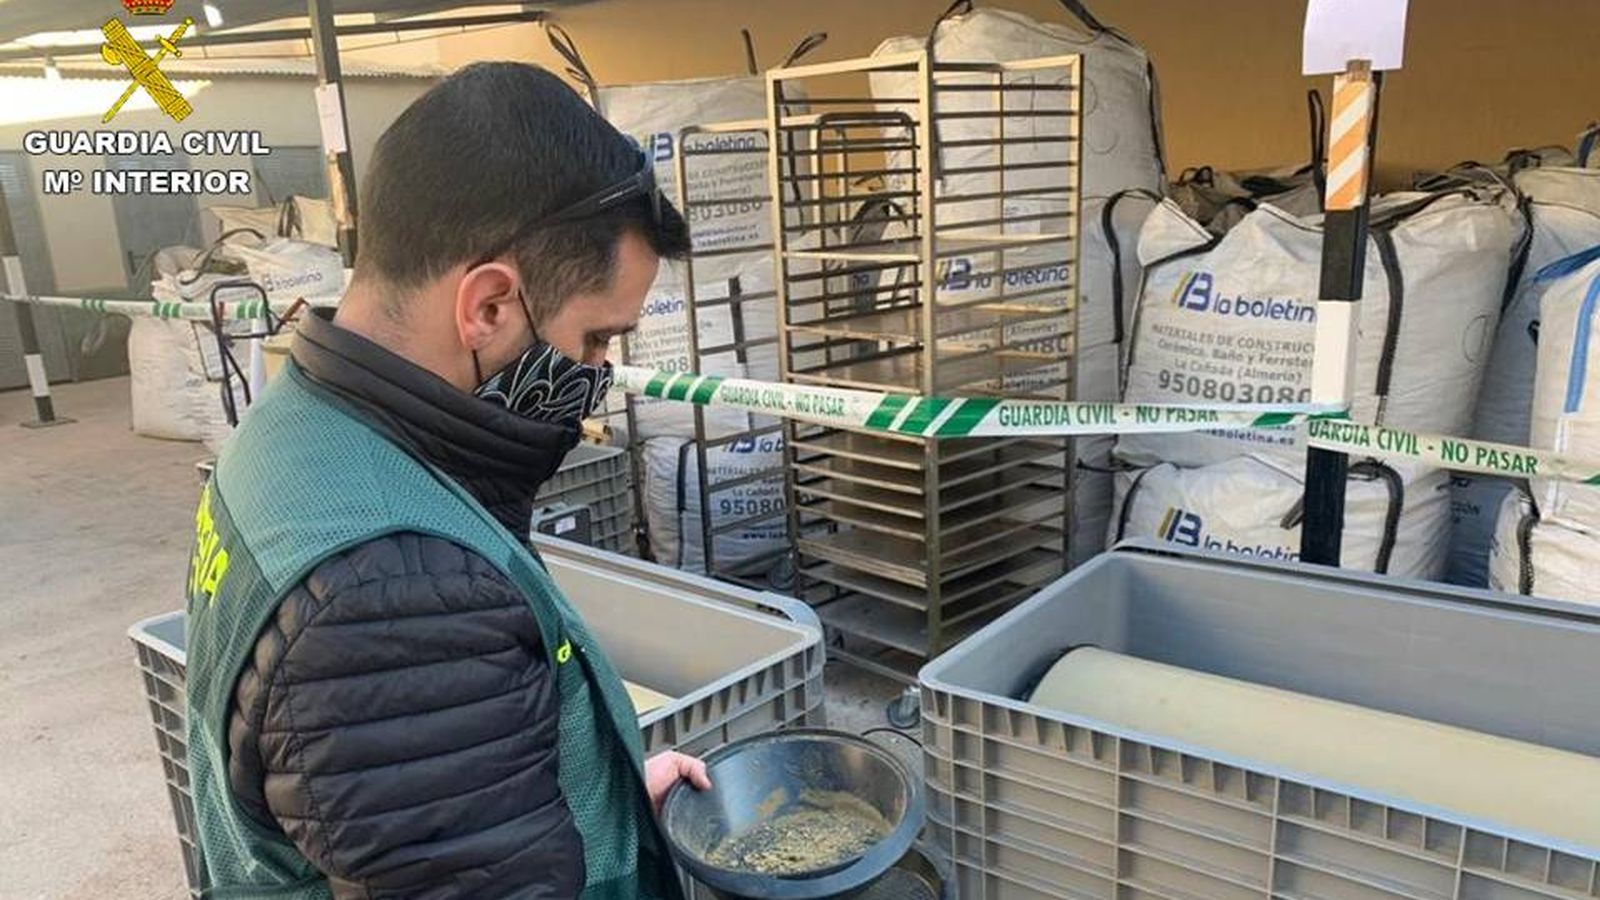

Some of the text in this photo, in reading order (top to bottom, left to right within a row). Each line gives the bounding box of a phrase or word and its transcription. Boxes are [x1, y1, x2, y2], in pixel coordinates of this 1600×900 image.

[1213, 293, 1231, 315] la
[1216, 334, 1233, 347] DE
[1158, 369, 1312, 404] 950803080
[1000, 405, 1070, 426] GUARDIA
[1076, 404, 1117, 425] CIVIL
[1136, 406, 1160, 424] NO
[1166, 407, 1219, 423] PASAR
[1376, 427, 1420, 456] CIVIL
[1441, 440, 1469, 464] NO
[1475, 446, 1539, 475] PASAR
